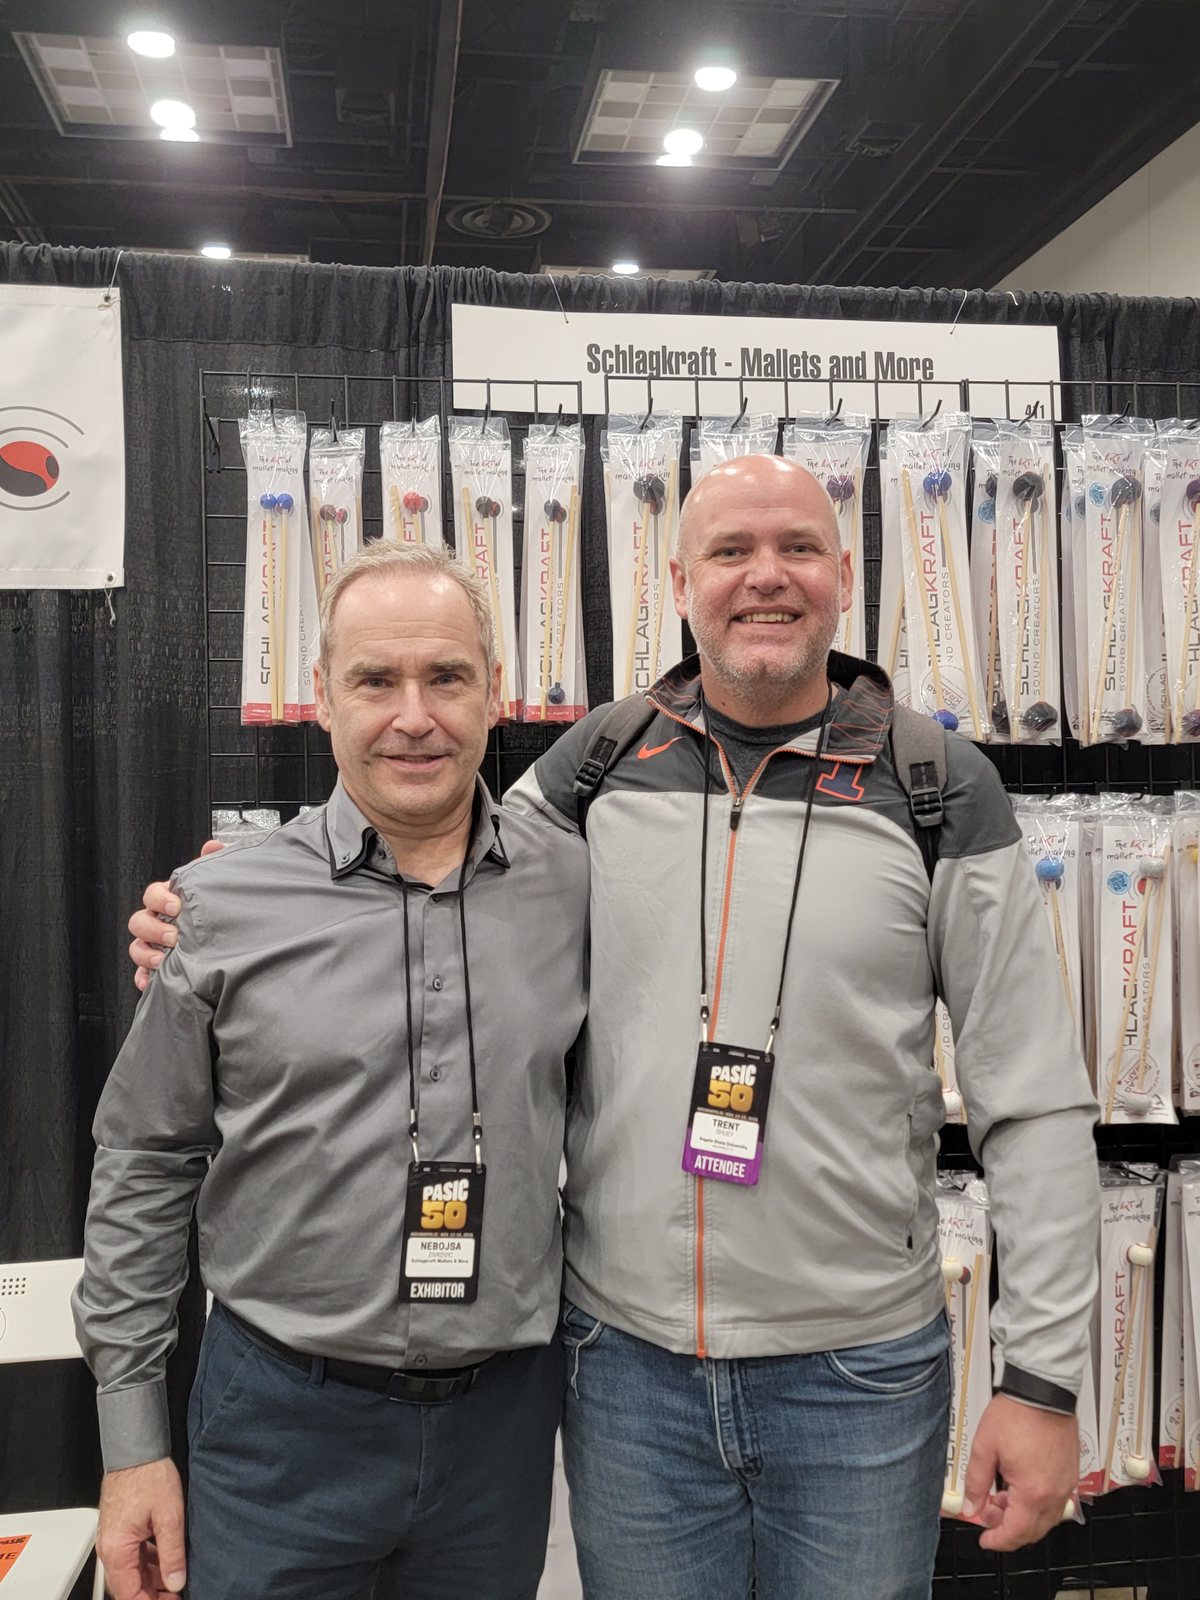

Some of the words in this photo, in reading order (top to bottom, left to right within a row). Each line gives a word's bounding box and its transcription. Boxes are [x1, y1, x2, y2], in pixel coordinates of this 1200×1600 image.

[587, 343, 717, 377] Schlagkraft
[740, 347, 822, 378] Mallets
[829, 351, 866, 380] and
[875, 351, 934, 380] More
[806, 458, 818, 468] The
[942, 572, 953, 640] CREATORS
[1032, 578, 1041, 646] CREATORS
[1117, 574, 1126, 642] CREATORS
[1114, 840, 1127, 848] The
[1130, 839, 1146, 850] ART
[710, 1064, 757, 1086] PASIC
[708, 1078, 754, 1113] 50
[712, 1118, 740, 1132] TRENT
[694, 1154, 746, 1178] ATTENDEE
[422, 1178, 469, 1202] PASIC
[420, 1200, 468, 1230] 50
[421, 1242, 461, 1251] NEBOJSA
[955, 1232, 983, 1246] making
[410, 1282, 465, 1298] EXHIBITOR
